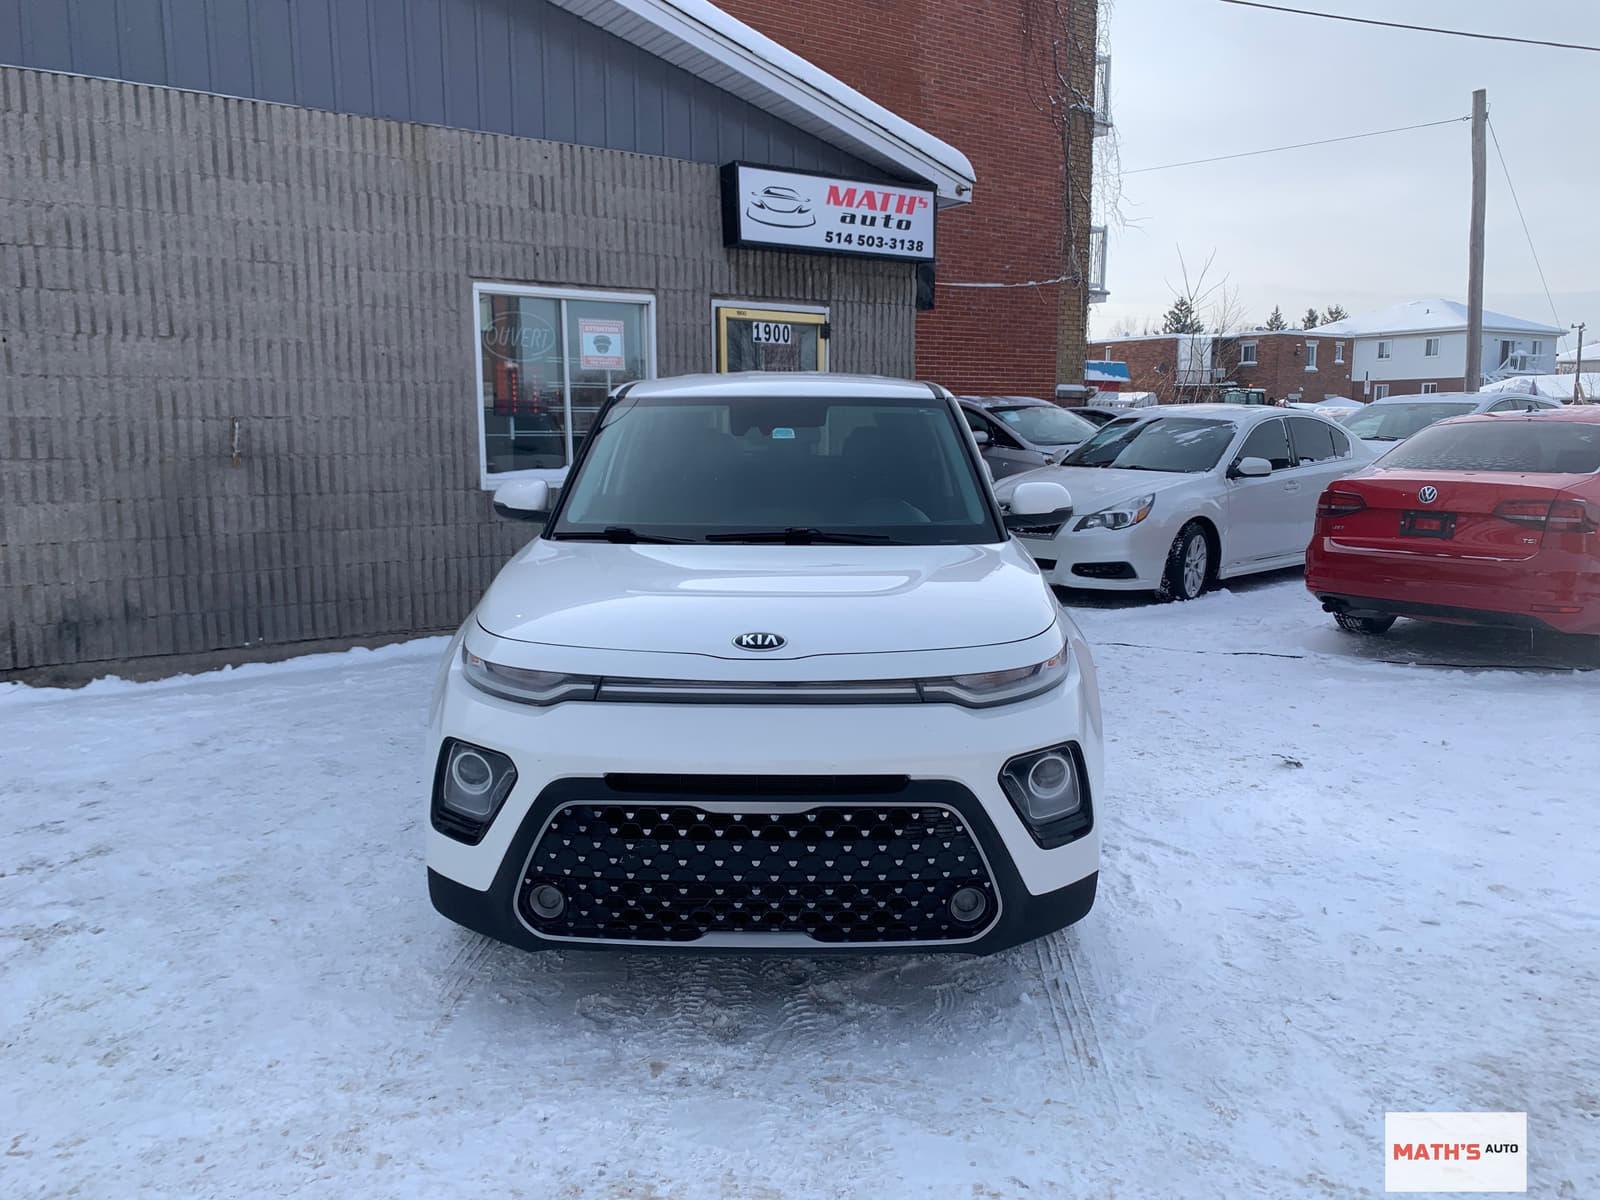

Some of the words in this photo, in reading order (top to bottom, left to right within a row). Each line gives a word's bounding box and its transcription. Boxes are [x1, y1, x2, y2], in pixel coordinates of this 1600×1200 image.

[840, 212, 911, 230] auto
[825, 231, 853, 245] 514
[857, 234, 924, 252] 503-3138
[486, 326, 550, 349] OUVERT
[754, 323, 790, 343] 1900
[742, 634, 778, 645] KIA
